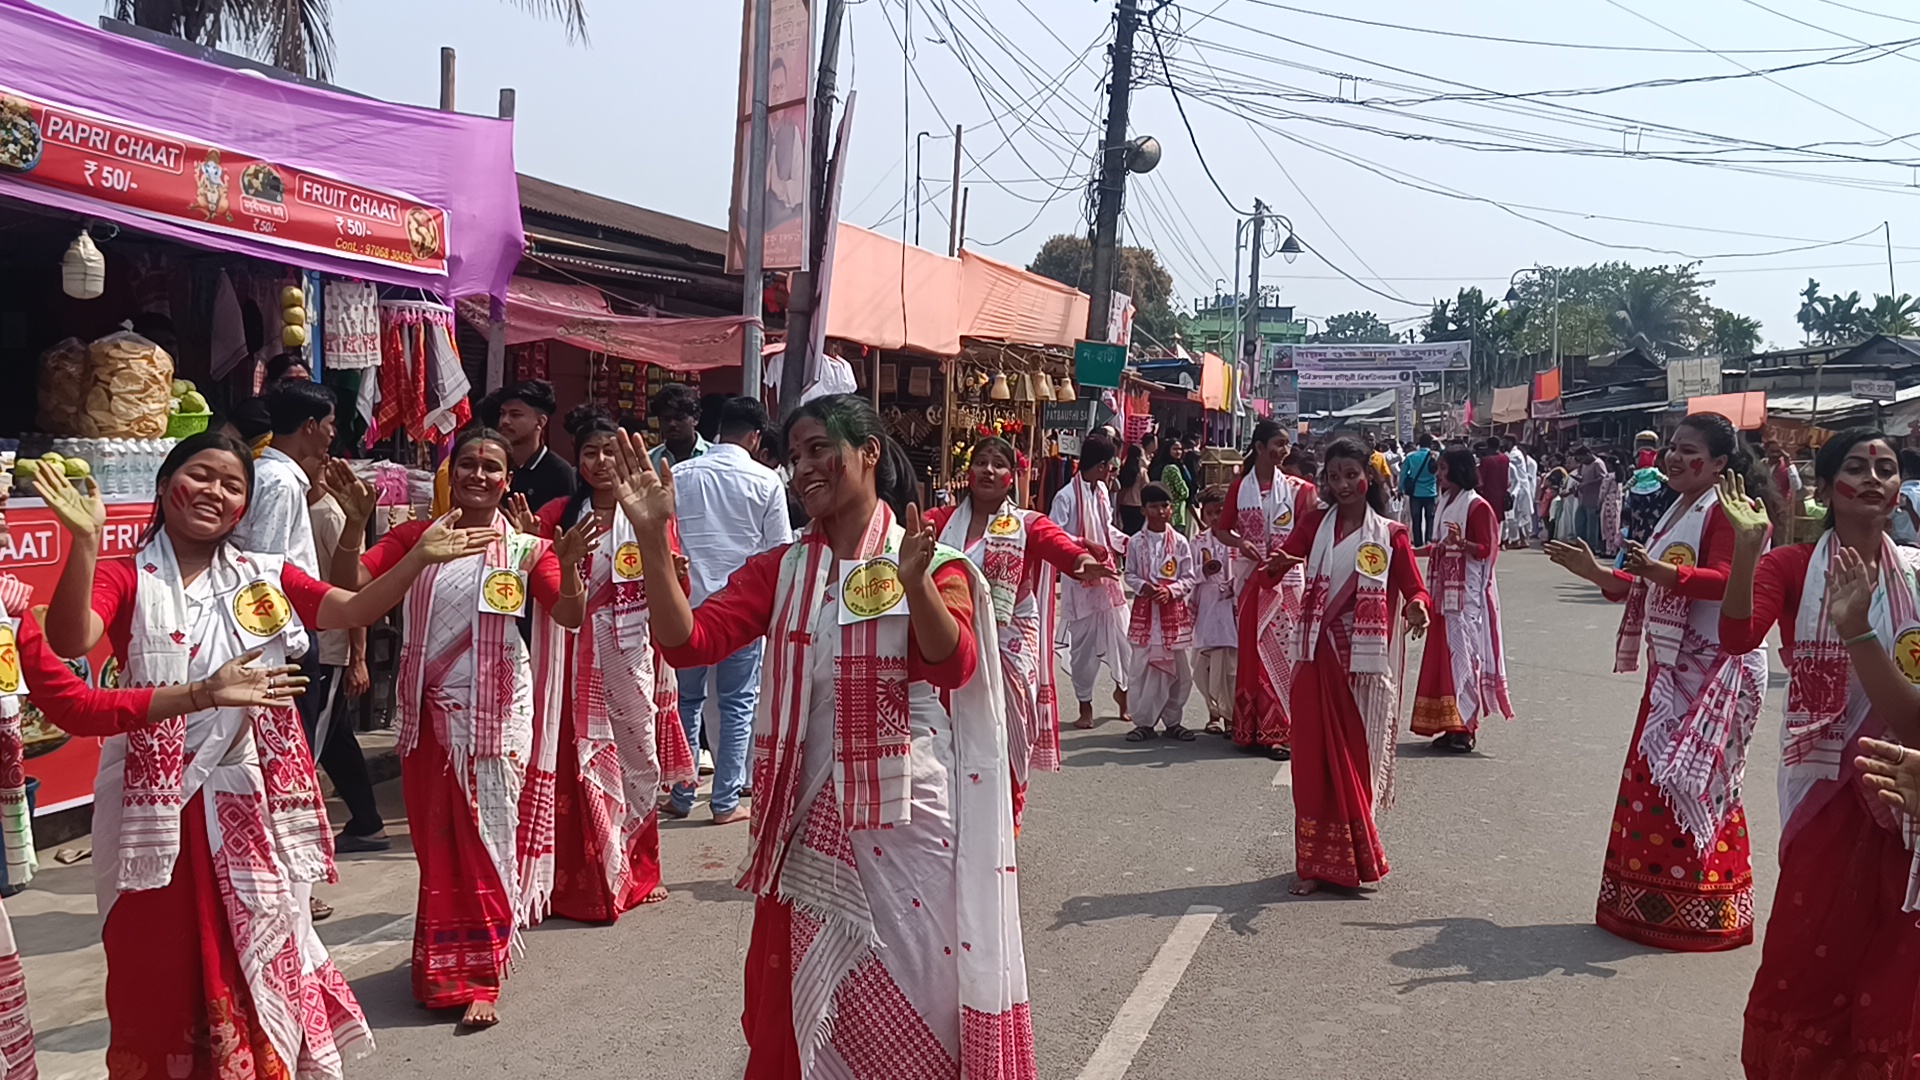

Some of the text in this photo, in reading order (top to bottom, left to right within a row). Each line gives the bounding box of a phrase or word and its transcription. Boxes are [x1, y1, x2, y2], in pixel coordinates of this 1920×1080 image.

[47, 116, 180, 168] PAPRI CHAAT
[84, 160, 138, 192] ₹ 50/-
[303, 180, 397, 221] FRUIT CHAAT
[347, 219, 372, 237] 50/-
[1061, 438, 1076, 450] 50
[621, 553, 637, 568] ক
[495, 582, 514, 600] ক
[246, 593, 275, 618] ক
